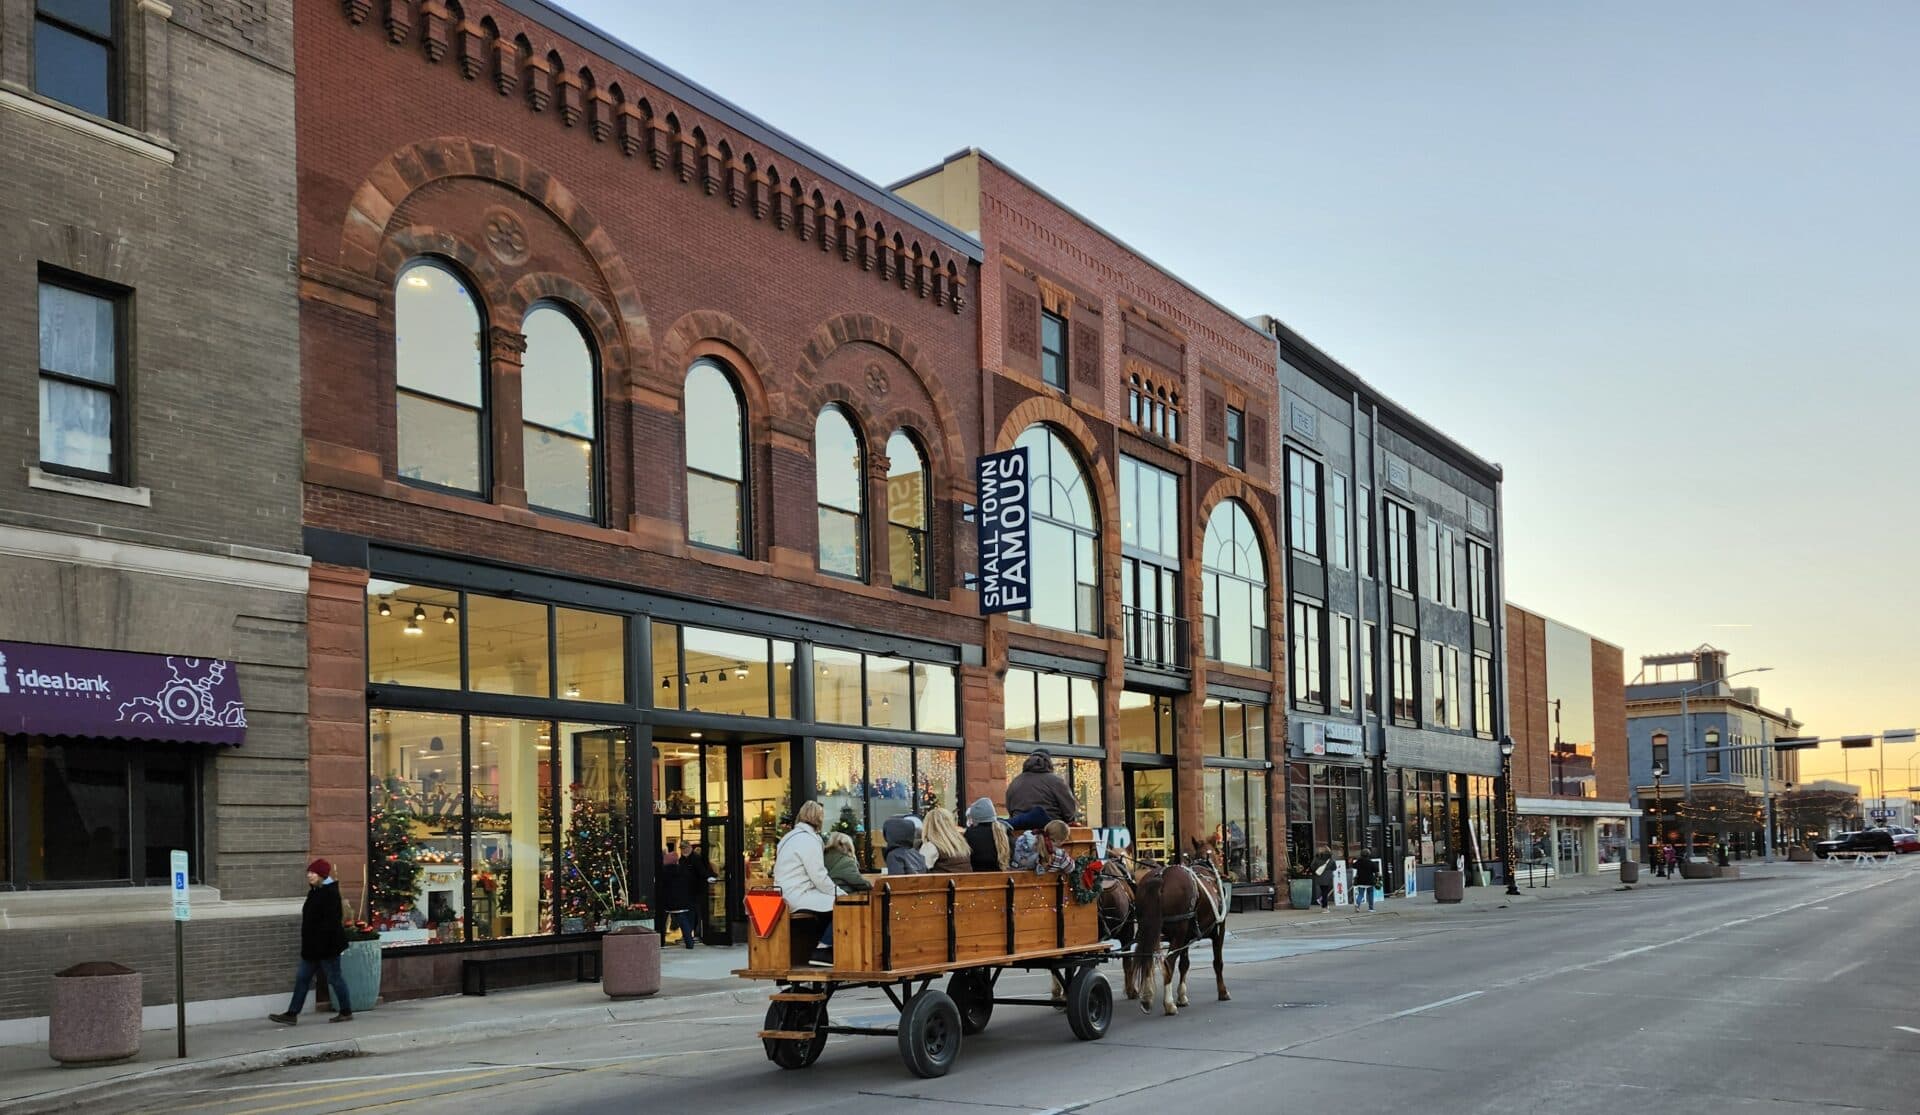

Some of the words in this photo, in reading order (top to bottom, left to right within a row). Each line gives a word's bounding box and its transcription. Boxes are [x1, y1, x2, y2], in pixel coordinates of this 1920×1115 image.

[982, 460, 998, 526] TOWN
[1000, 454, 1027, 606] FAMOUS
[983, 530, 999, 607] SMALL
[20, 688, 111, 700] MARKETING
